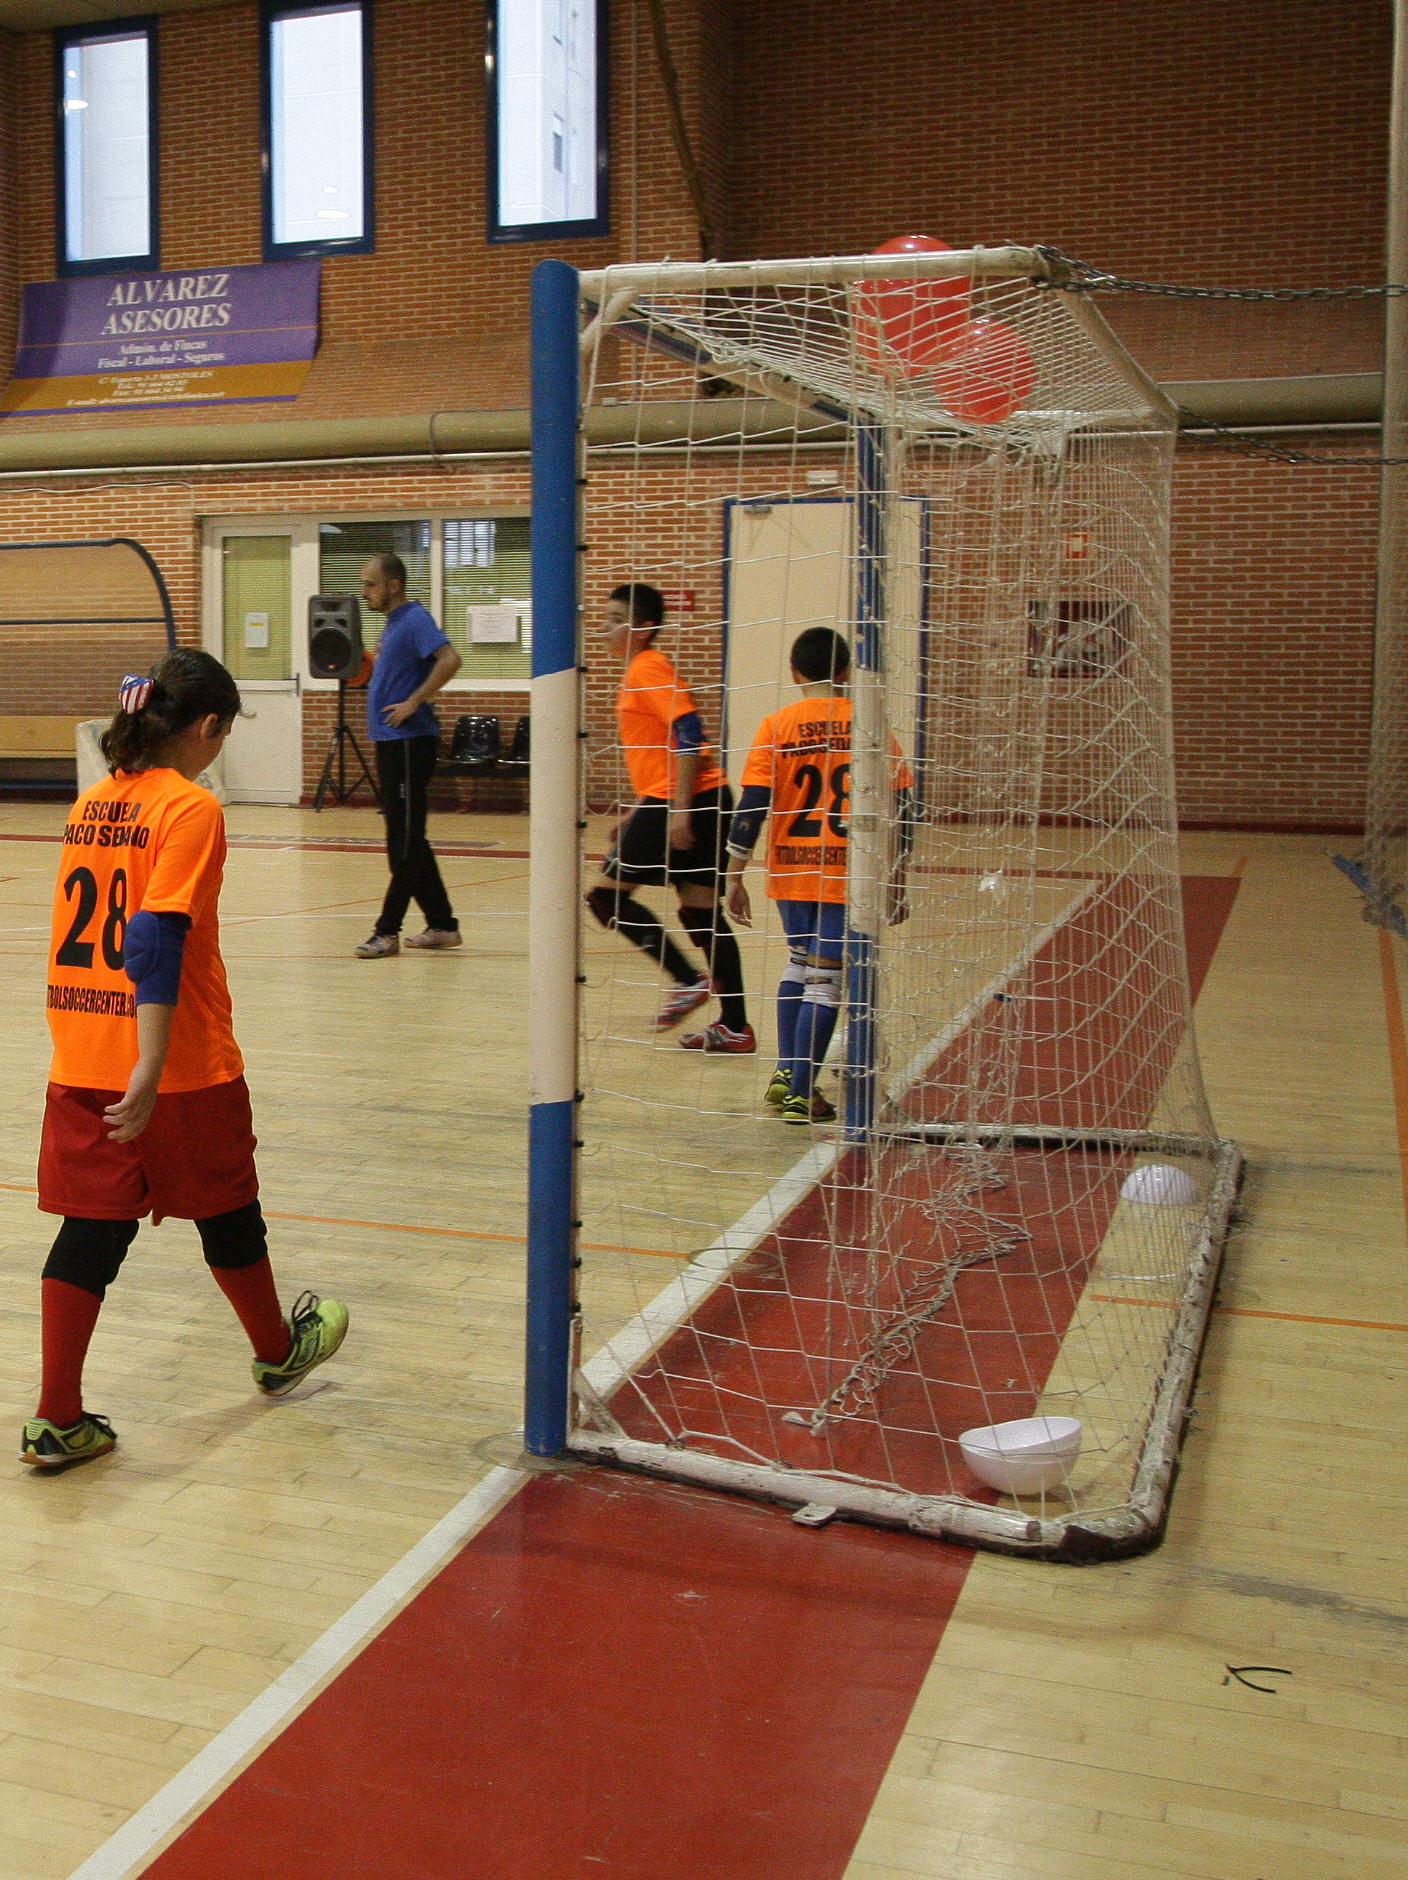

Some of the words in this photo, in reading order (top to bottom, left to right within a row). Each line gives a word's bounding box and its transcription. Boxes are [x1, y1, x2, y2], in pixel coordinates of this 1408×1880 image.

[106, 274, 230, 306] ALVAREZ
[100, 302, 233, 336] ASESORES
[788, 763, 851, 837] 28
[55, 866, 128, 971] 28
